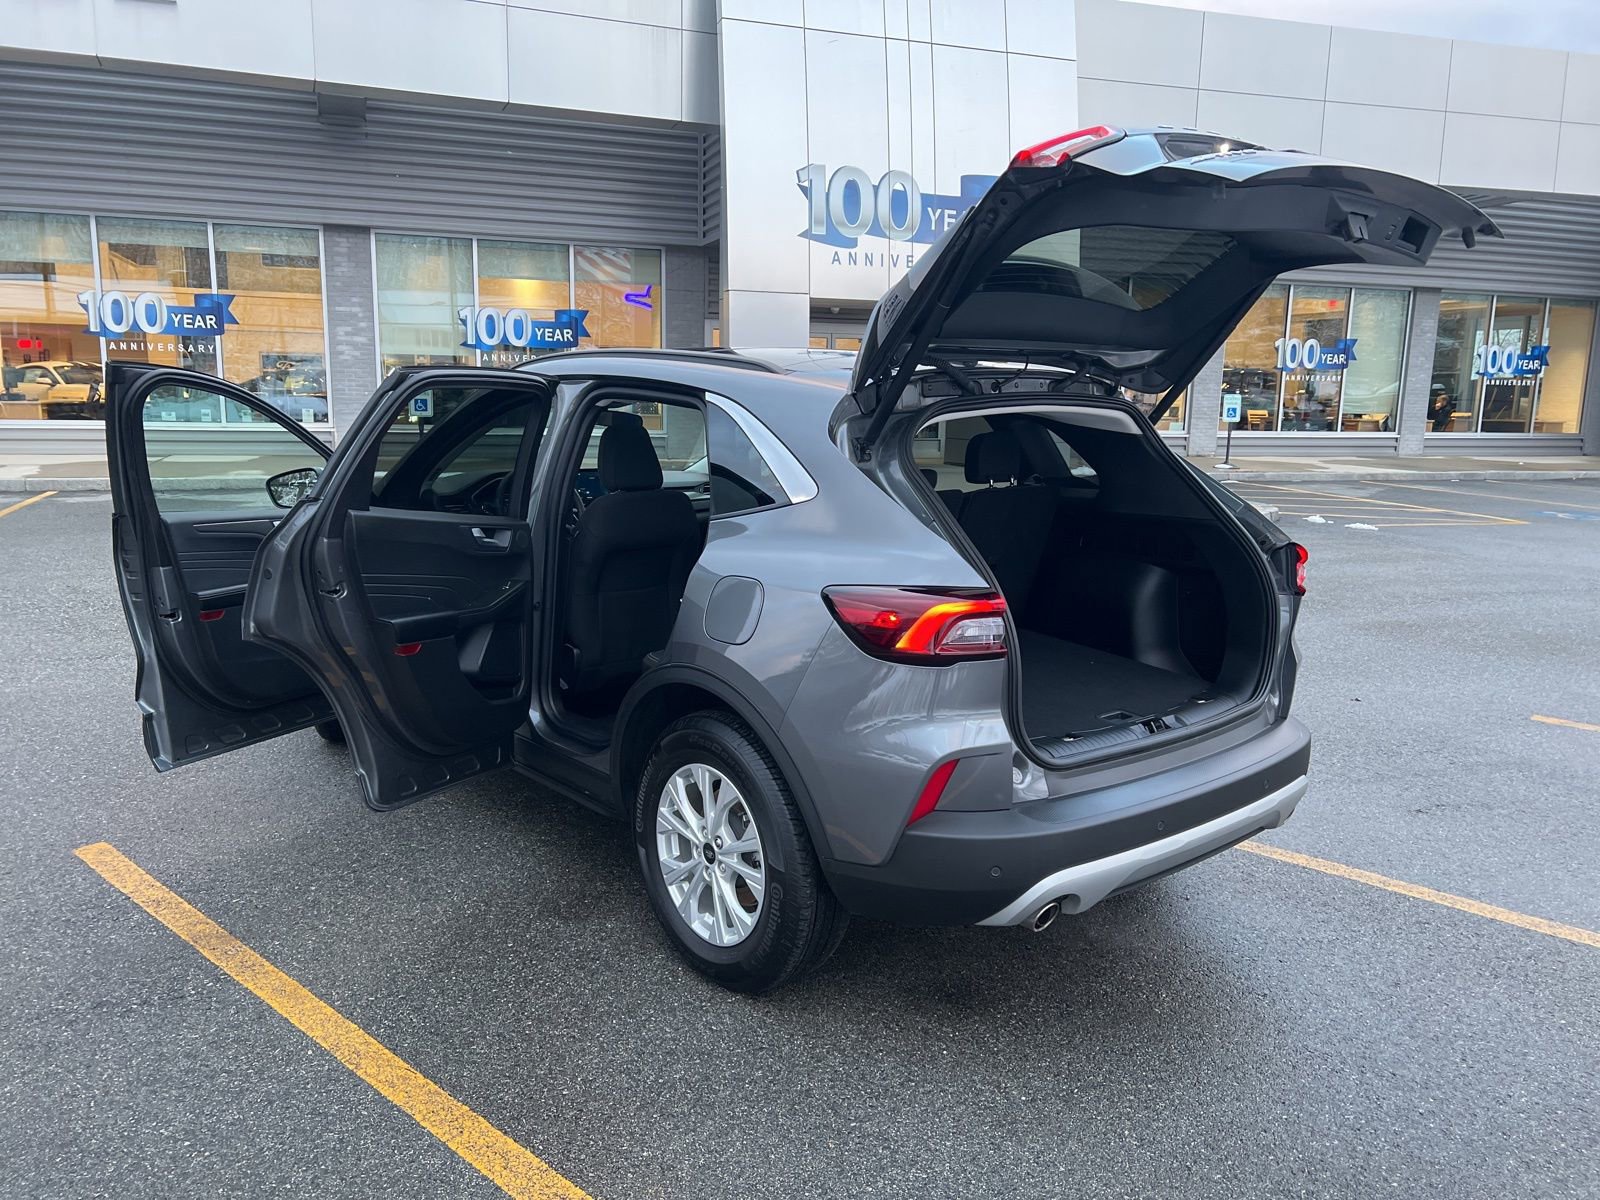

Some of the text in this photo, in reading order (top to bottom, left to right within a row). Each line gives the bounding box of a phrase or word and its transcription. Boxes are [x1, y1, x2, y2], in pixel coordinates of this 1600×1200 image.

[796, 163, 922, 241] 100
[832, 250, 914, 269] ANNIVE
[77, 290, 218, 334] 100 YEAR
[458, 306, 574, 347] 100 YEAR
[109, 341, 215, 353] ANNIVERSARY
[482, 353, 537, 362] ANNIVER
[1274, 337, 1321, 369] 100
[1478, 345, 1541, 374] 100 YEAR
[1285, 374, 1342, 382] ANNIVERSARY
